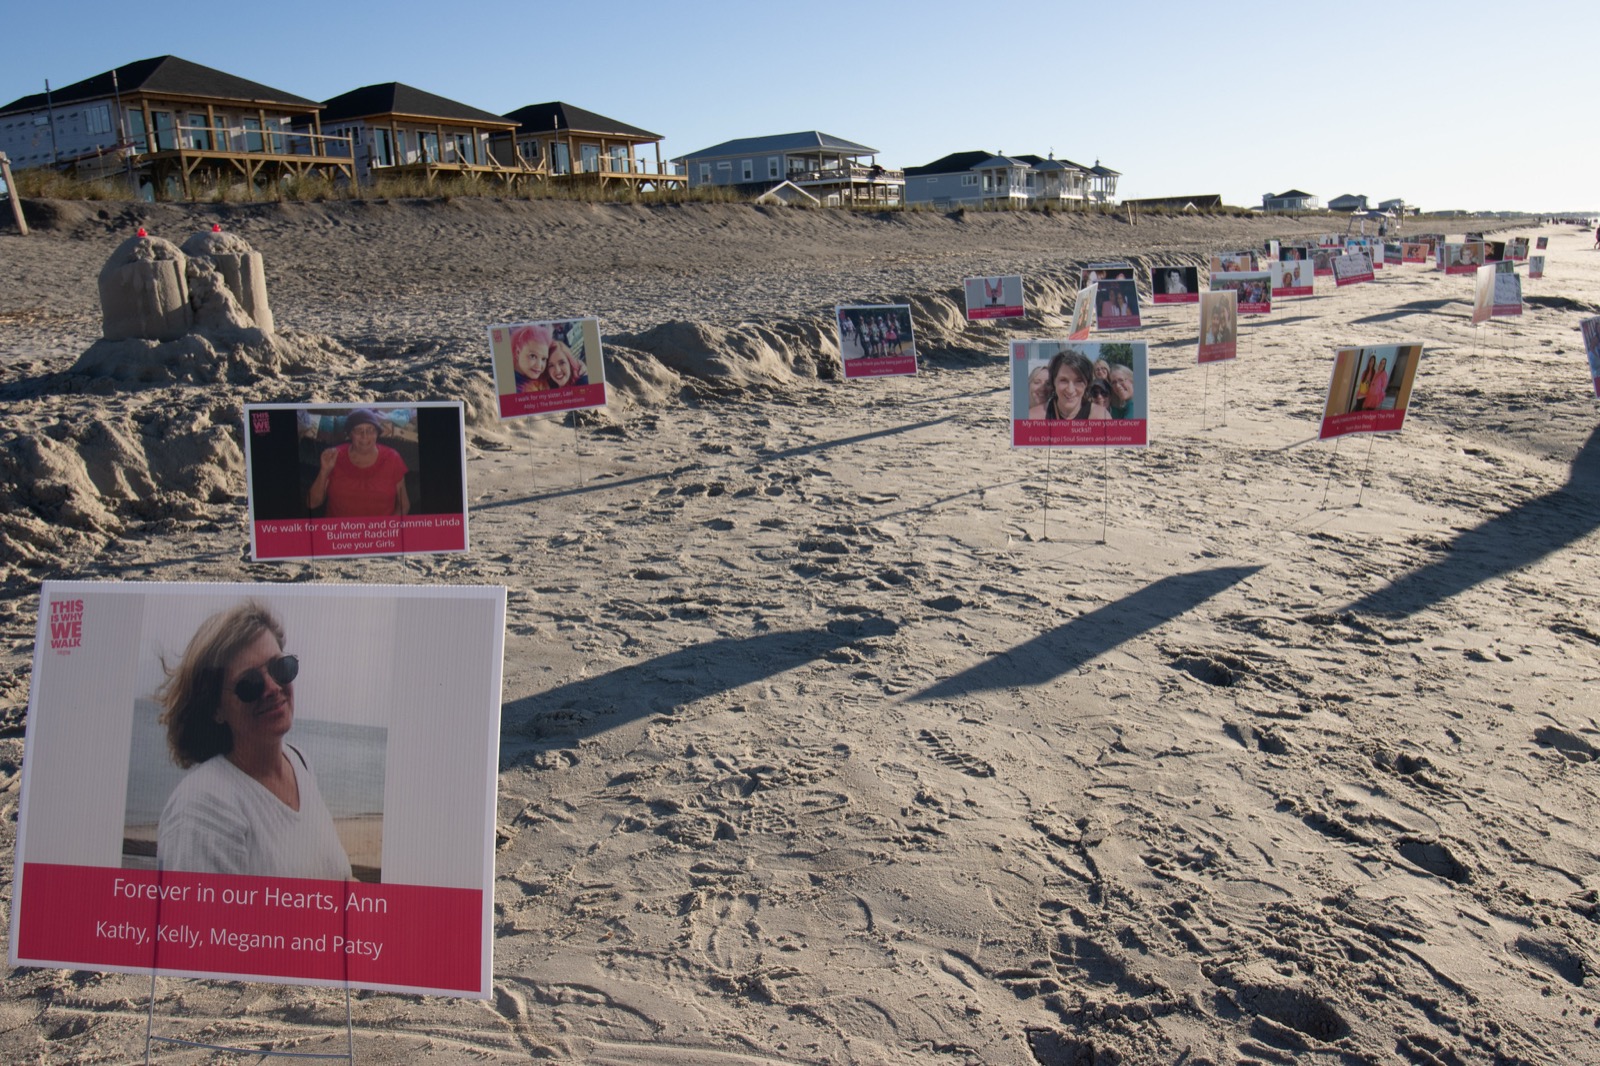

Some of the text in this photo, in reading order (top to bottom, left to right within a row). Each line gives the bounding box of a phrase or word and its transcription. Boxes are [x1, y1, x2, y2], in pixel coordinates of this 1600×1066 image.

[253, 421, 270, 429] WE
[261, 517, 460, 533] We walk for our Mom and Grammie Linda
[327, 529, 399, 540] Bulmer Radcliff
[332, 540, 395, 550] Love your Girls
[51, 599, 83, 613] THIS
[61, 613, 83, 621] WHY
[50, 621, 82, 639] WE
[51, 638, 81, 648] WALK
[113, 878, 388, 914] Forever in our Hearts, Ann
[96, 921, 383, 961] Kathy, Kelly, Megann and Patsy
